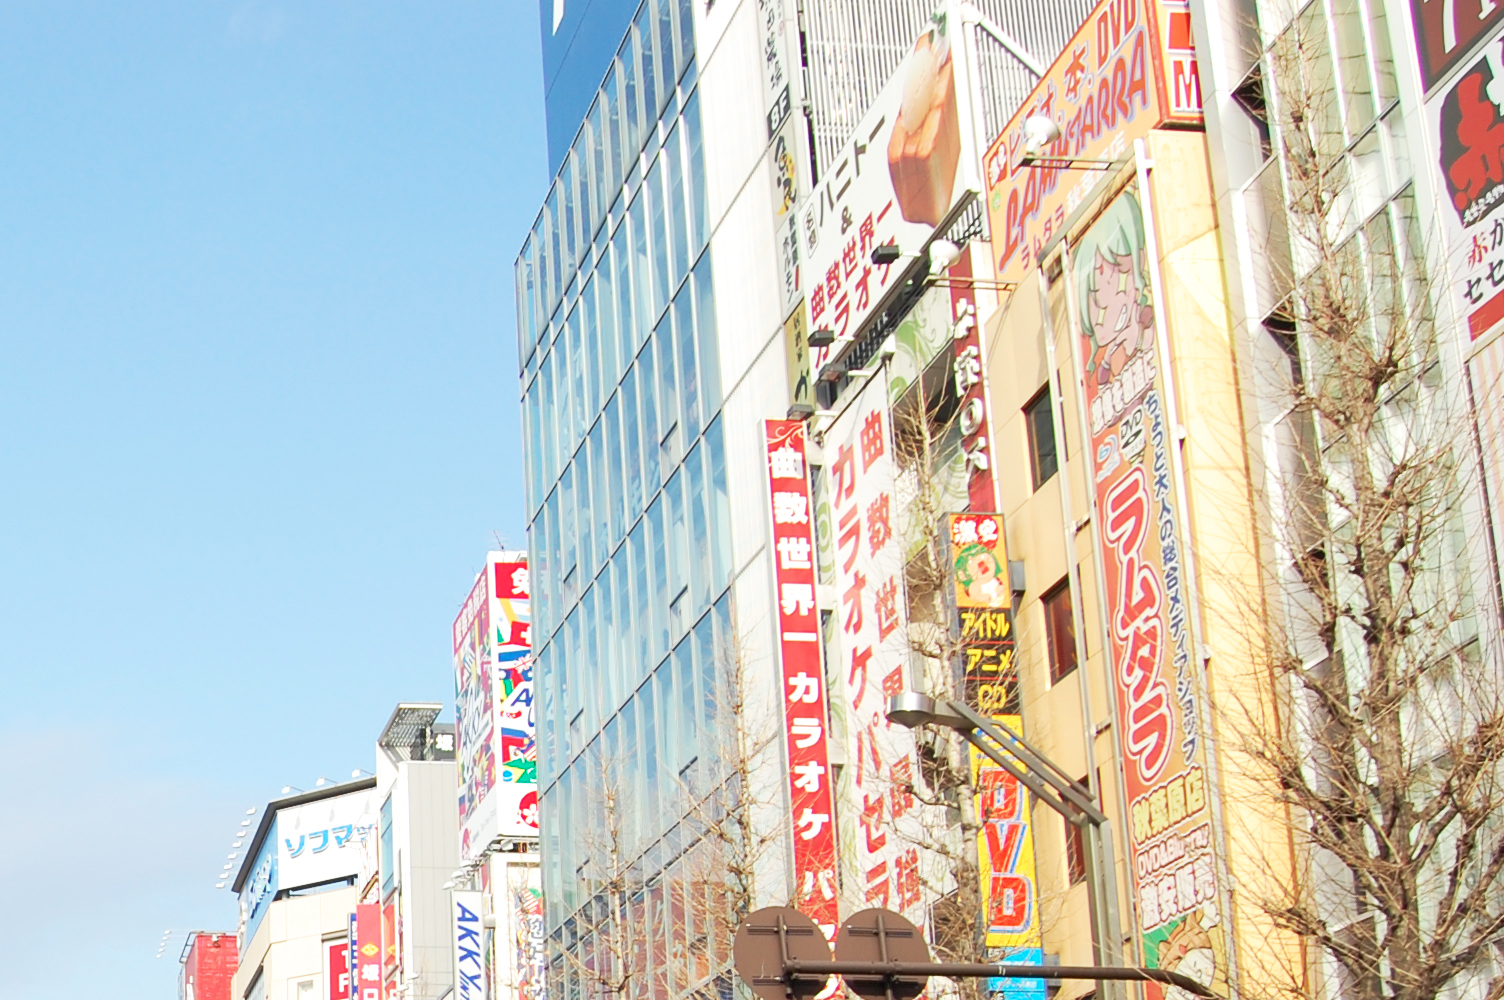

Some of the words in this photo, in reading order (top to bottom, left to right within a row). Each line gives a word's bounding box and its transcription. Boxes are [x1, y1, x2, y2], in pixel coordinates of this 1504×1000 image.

[769, 87, 789, 131] 8F
[819, 114, 885, 228] ハニトー
[810, 199, 893, 325] 曲数世界一
[960, 611, 1010, 638] アイドル
[966, 649, 1012, 673] アニメ
[1104, 465, 1174, 786] ラムタラ
[1132, 766, 1206, 846] 秋葉原店
[456, 901, 483, 993] AKKY
